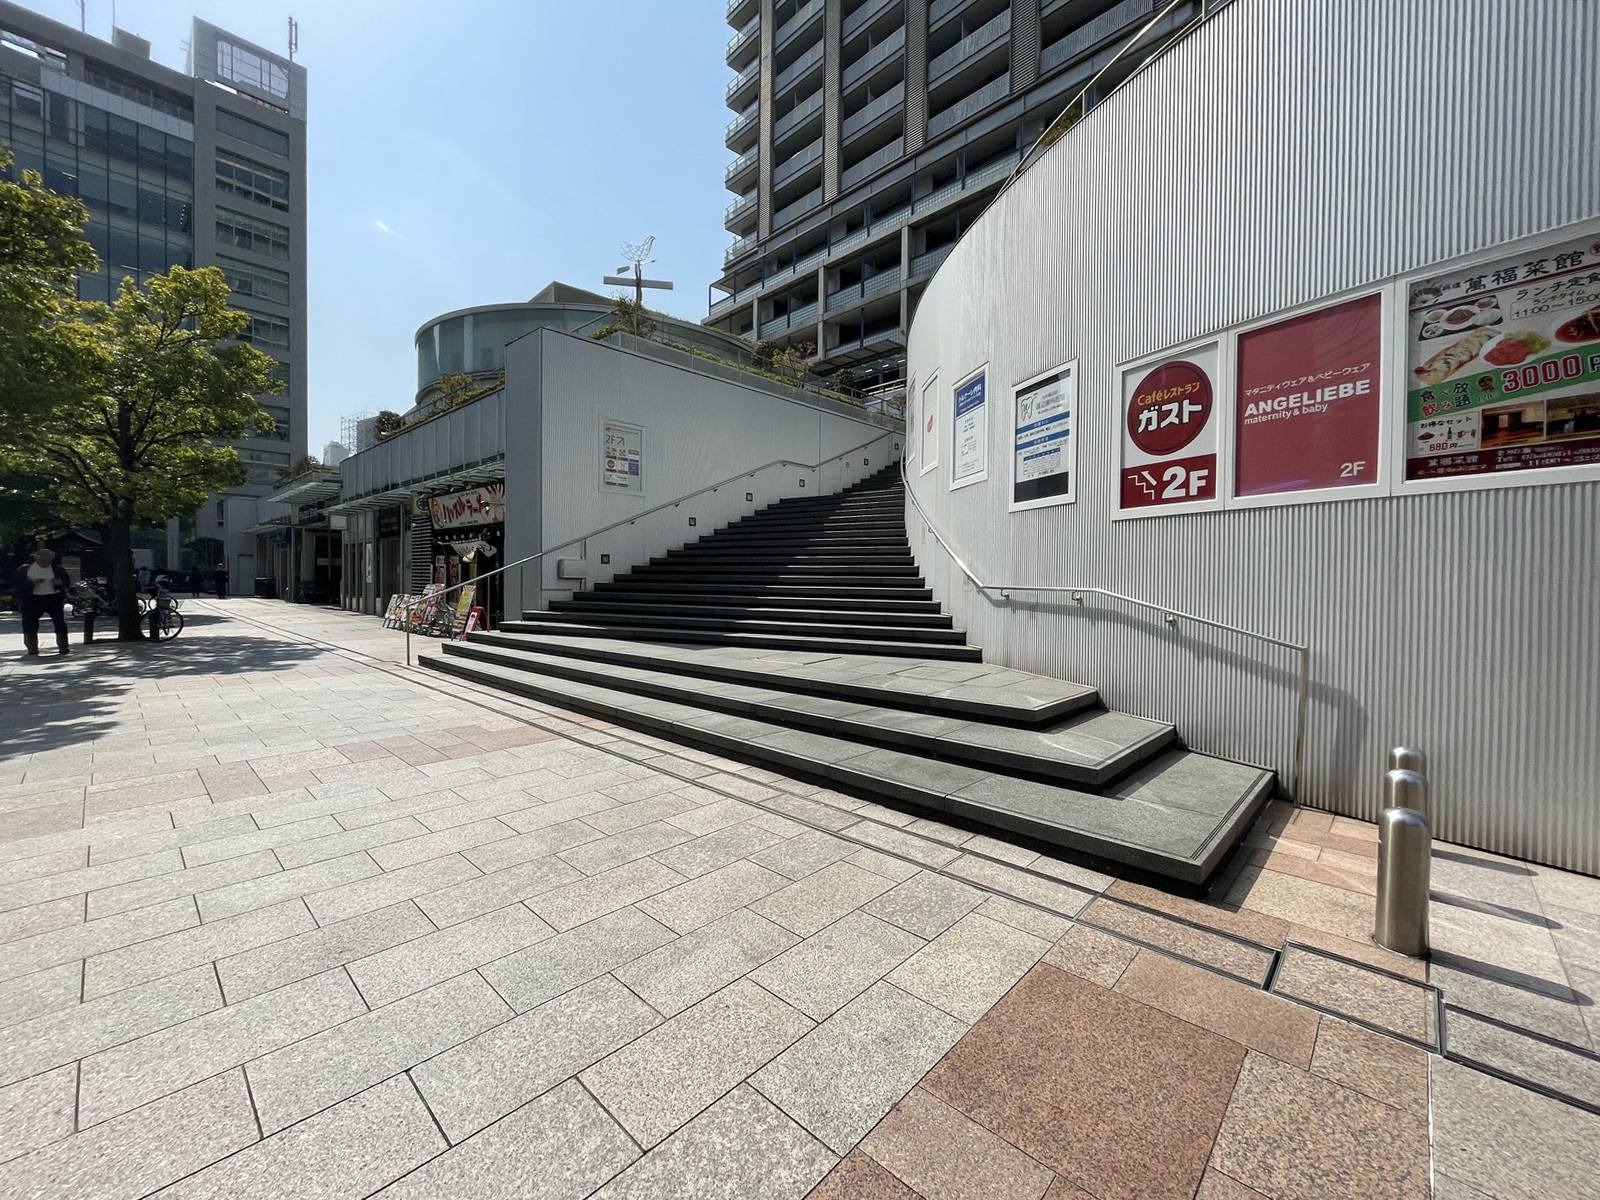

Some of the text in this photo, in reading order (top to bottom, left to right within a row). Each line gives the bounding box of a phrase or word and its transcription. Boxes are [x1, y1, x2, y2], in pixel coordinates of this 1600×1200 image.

[1465, 251, 1585, 294] 萬福菜館
[1244, 379, 1370, 417] ANGELIEBE
[1244, 403, 1328, 425] maternity & baby
[1137, 398, 1202, 434] ガスト
[605, 434, 616, 444] 2F
[1161, 465, 1209, 499] 2F
[1340, 461, 1366, 477] 2F
